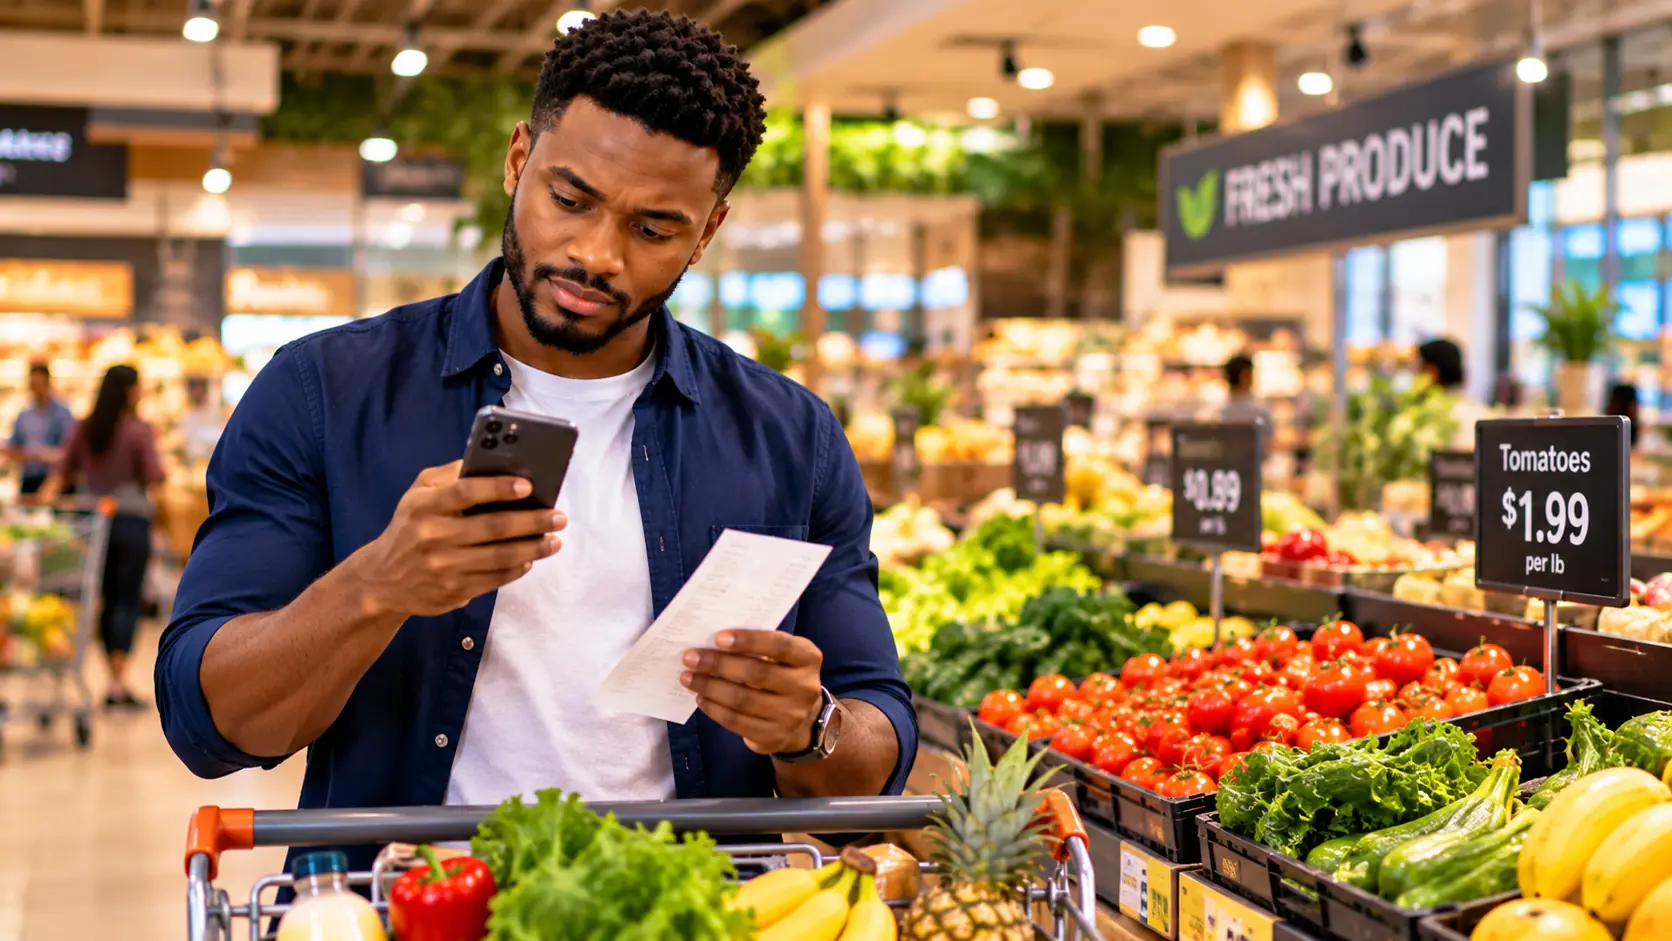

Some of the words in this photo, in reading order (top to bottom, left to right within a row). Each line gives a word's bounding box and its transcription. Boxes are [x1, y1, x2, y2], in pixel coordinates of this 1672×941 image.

[1224, 152, 1312, 227] FRESH
[1318, 106, 1490, 211] PRODUCE
[1499, 443, 1591, 473] Tomatoes
[1501, 486, 1590, 546] $1.99
[1525, 554, 1548, 575] per
[1551, 553, 1565, 574] lb
